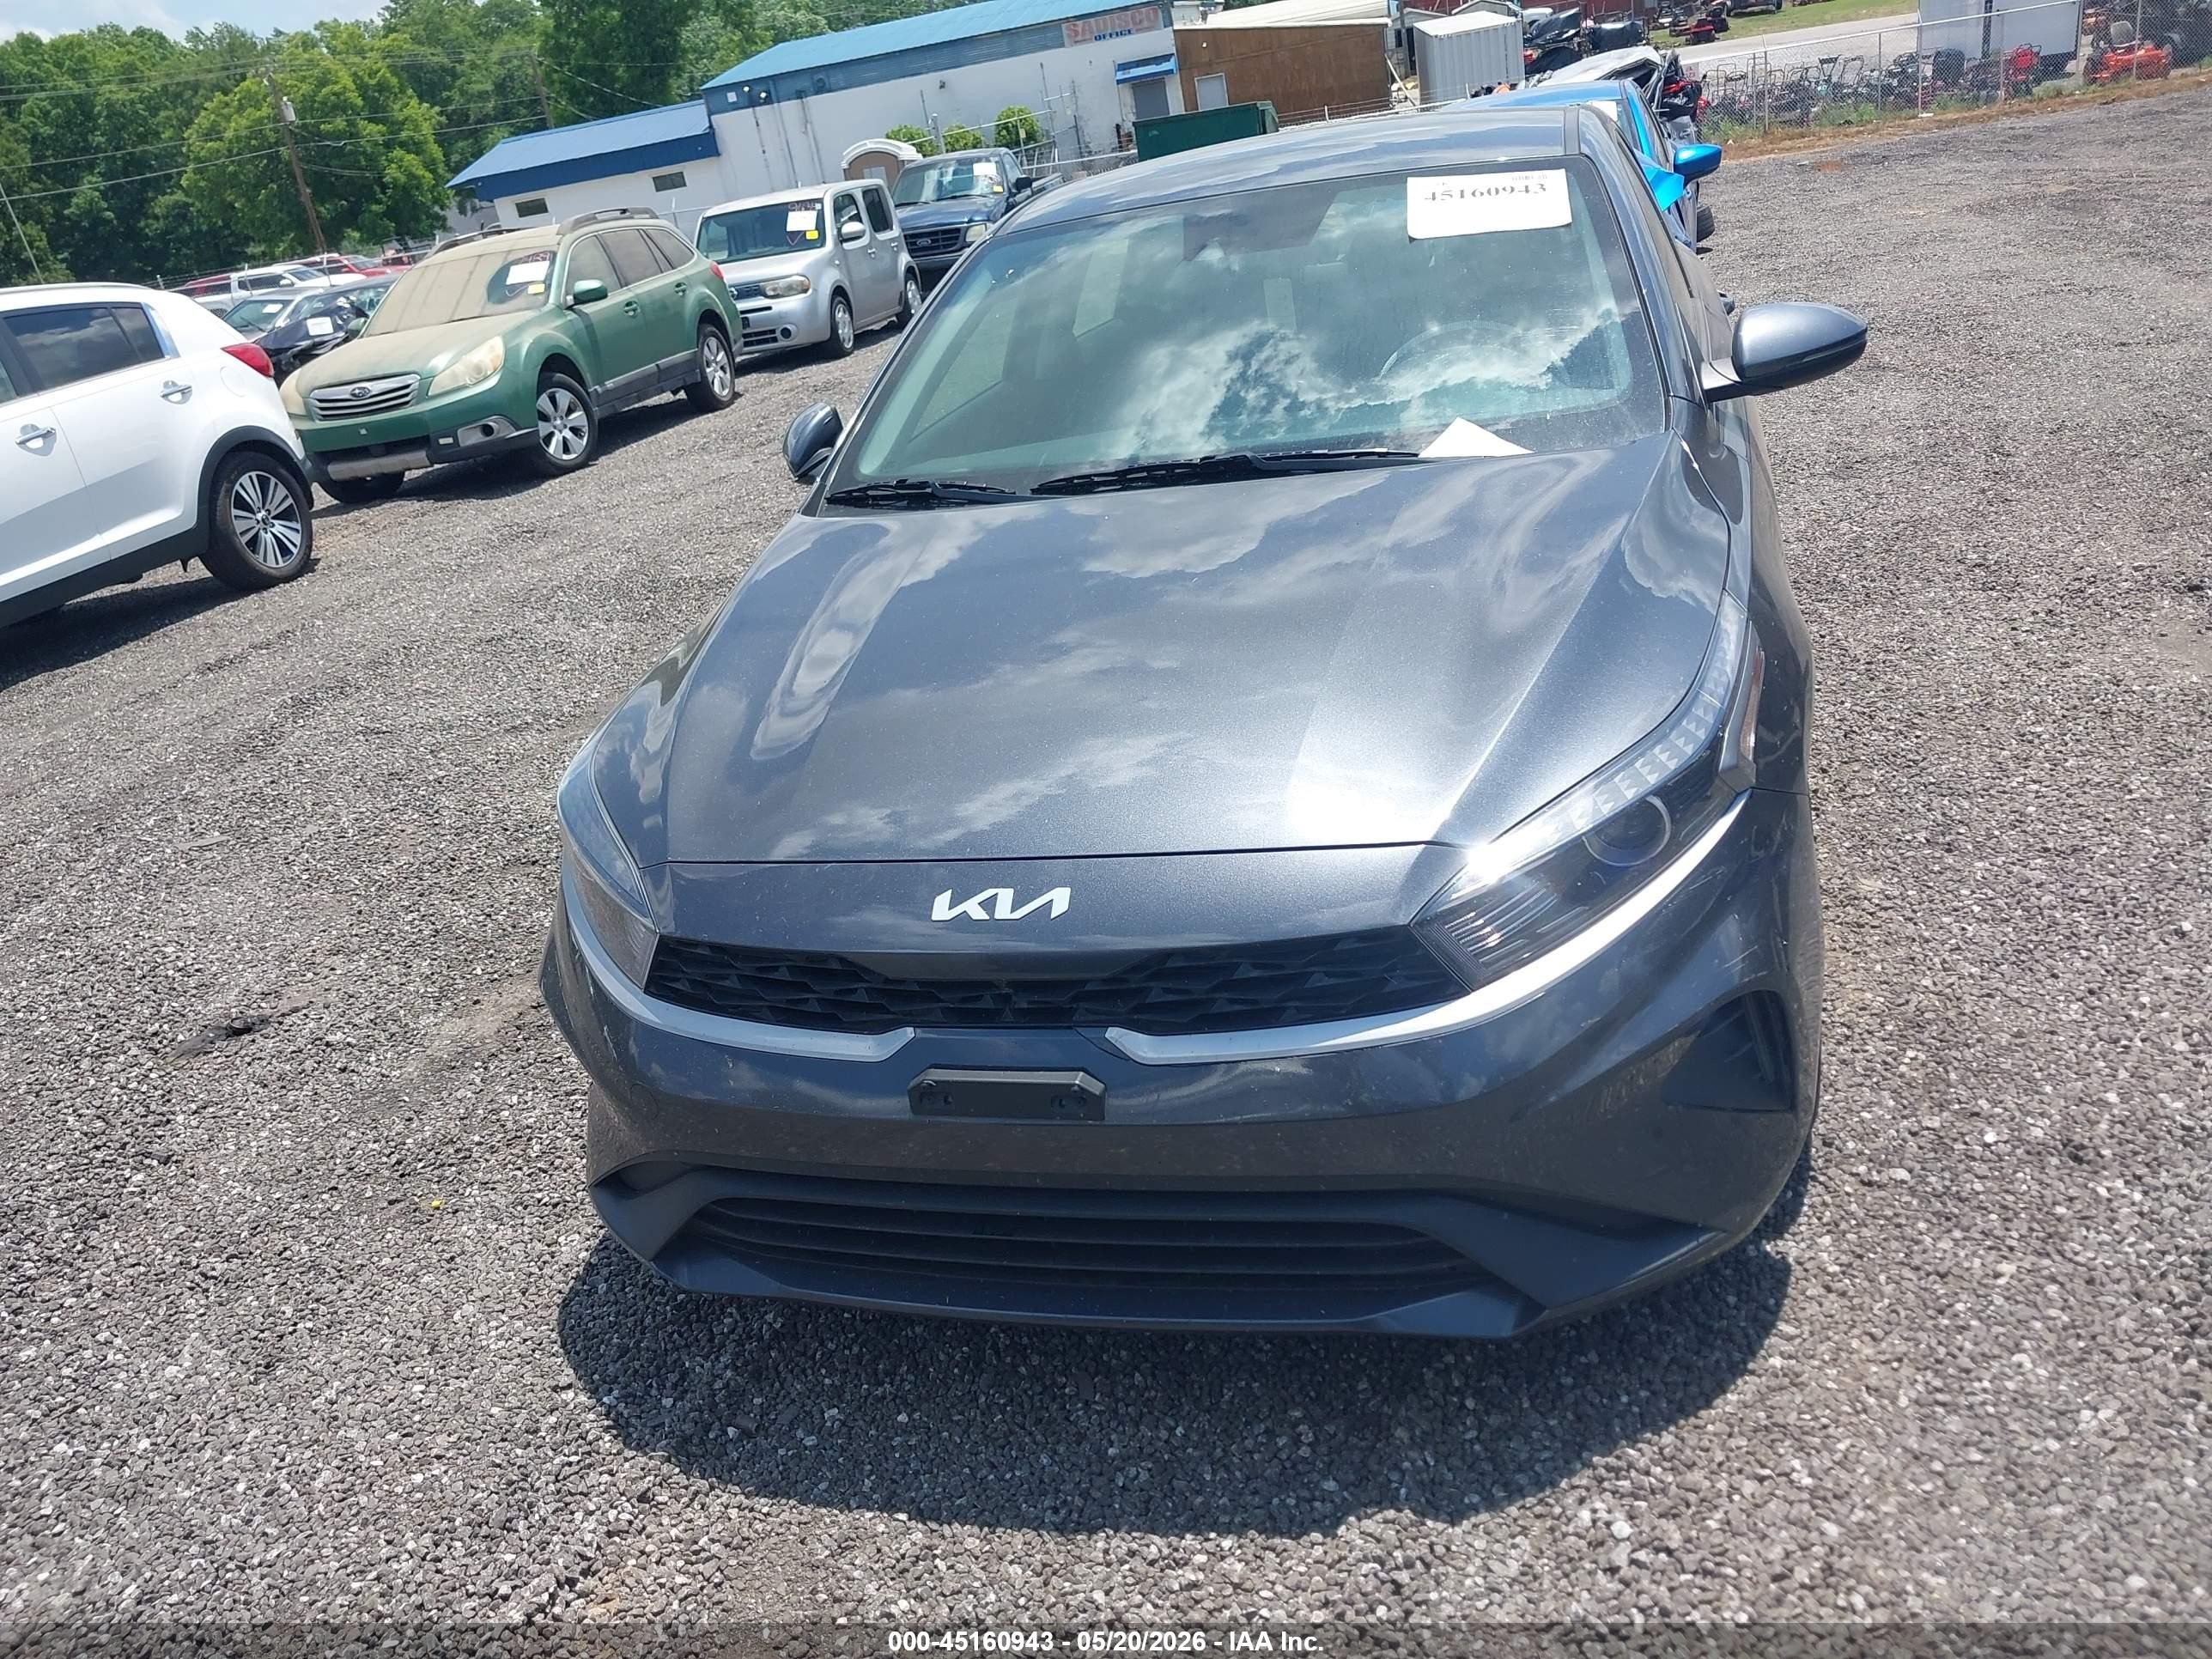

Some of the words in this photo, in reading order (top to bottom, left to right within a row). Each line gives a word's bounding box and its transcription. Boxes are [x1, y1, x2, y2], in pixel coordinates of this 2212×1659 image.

[1066, 7, 1159, 39] SADISCO
[1093, 28, 1134, 41] OFFICE
[1423, 183, 1547, 202] 45160943
[931, 886, 1073, 921] KIA
